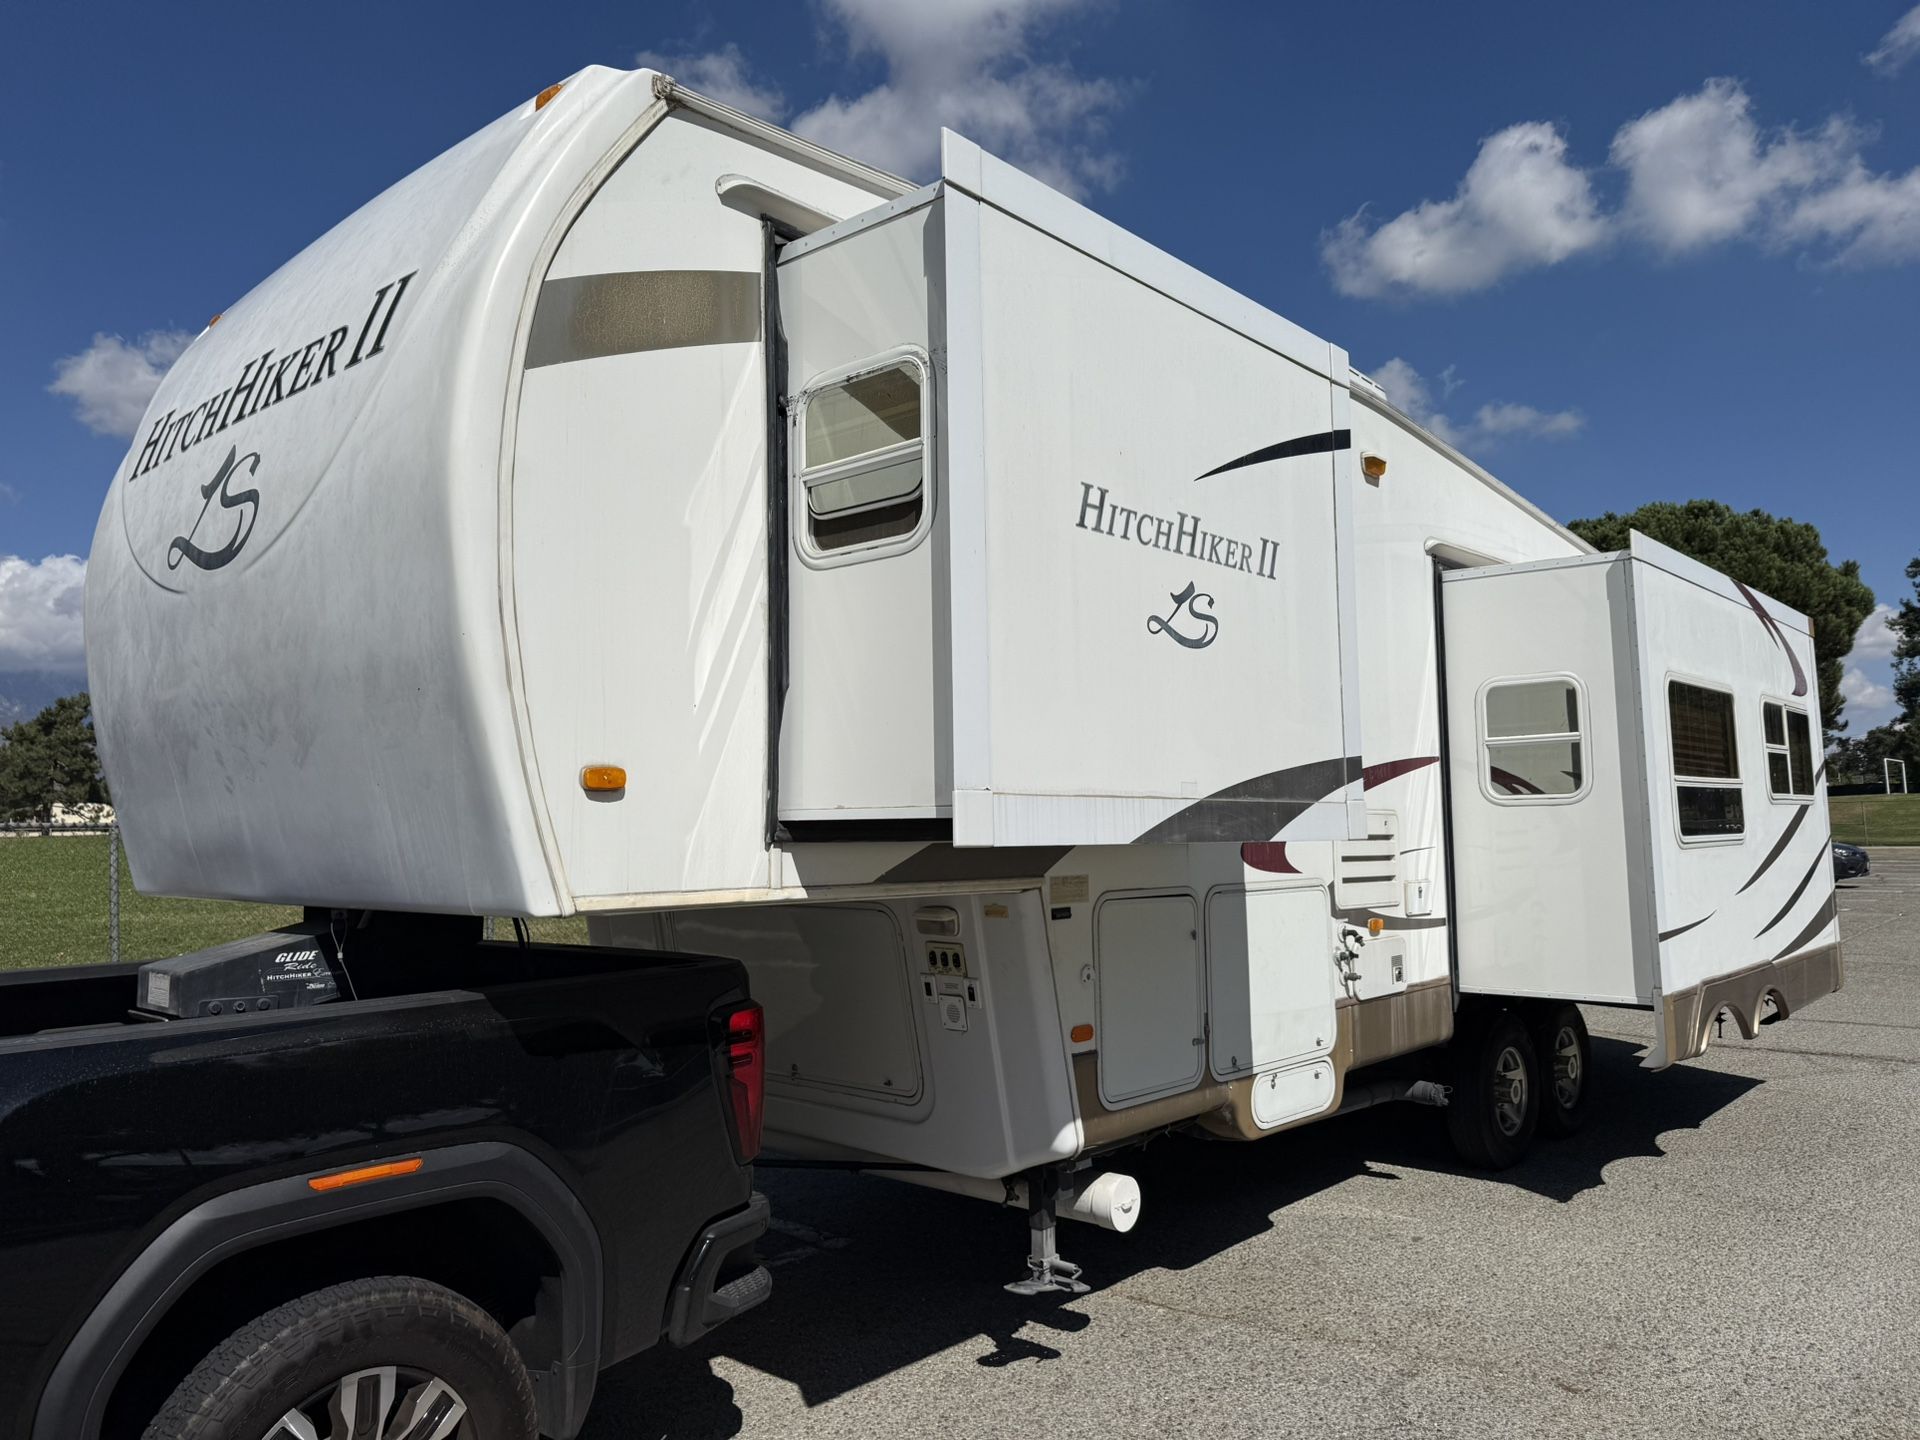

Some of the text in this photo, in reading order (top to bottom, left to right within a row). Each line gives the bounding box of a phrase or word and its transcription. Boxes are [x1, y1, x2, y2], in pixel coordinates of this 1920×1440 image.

[344, 269, 419, 370] II
[1256, 537, 1280, 580] II
[275, 950, 319, 963] GLIDE
[283, 961, 318, 971] Ride
